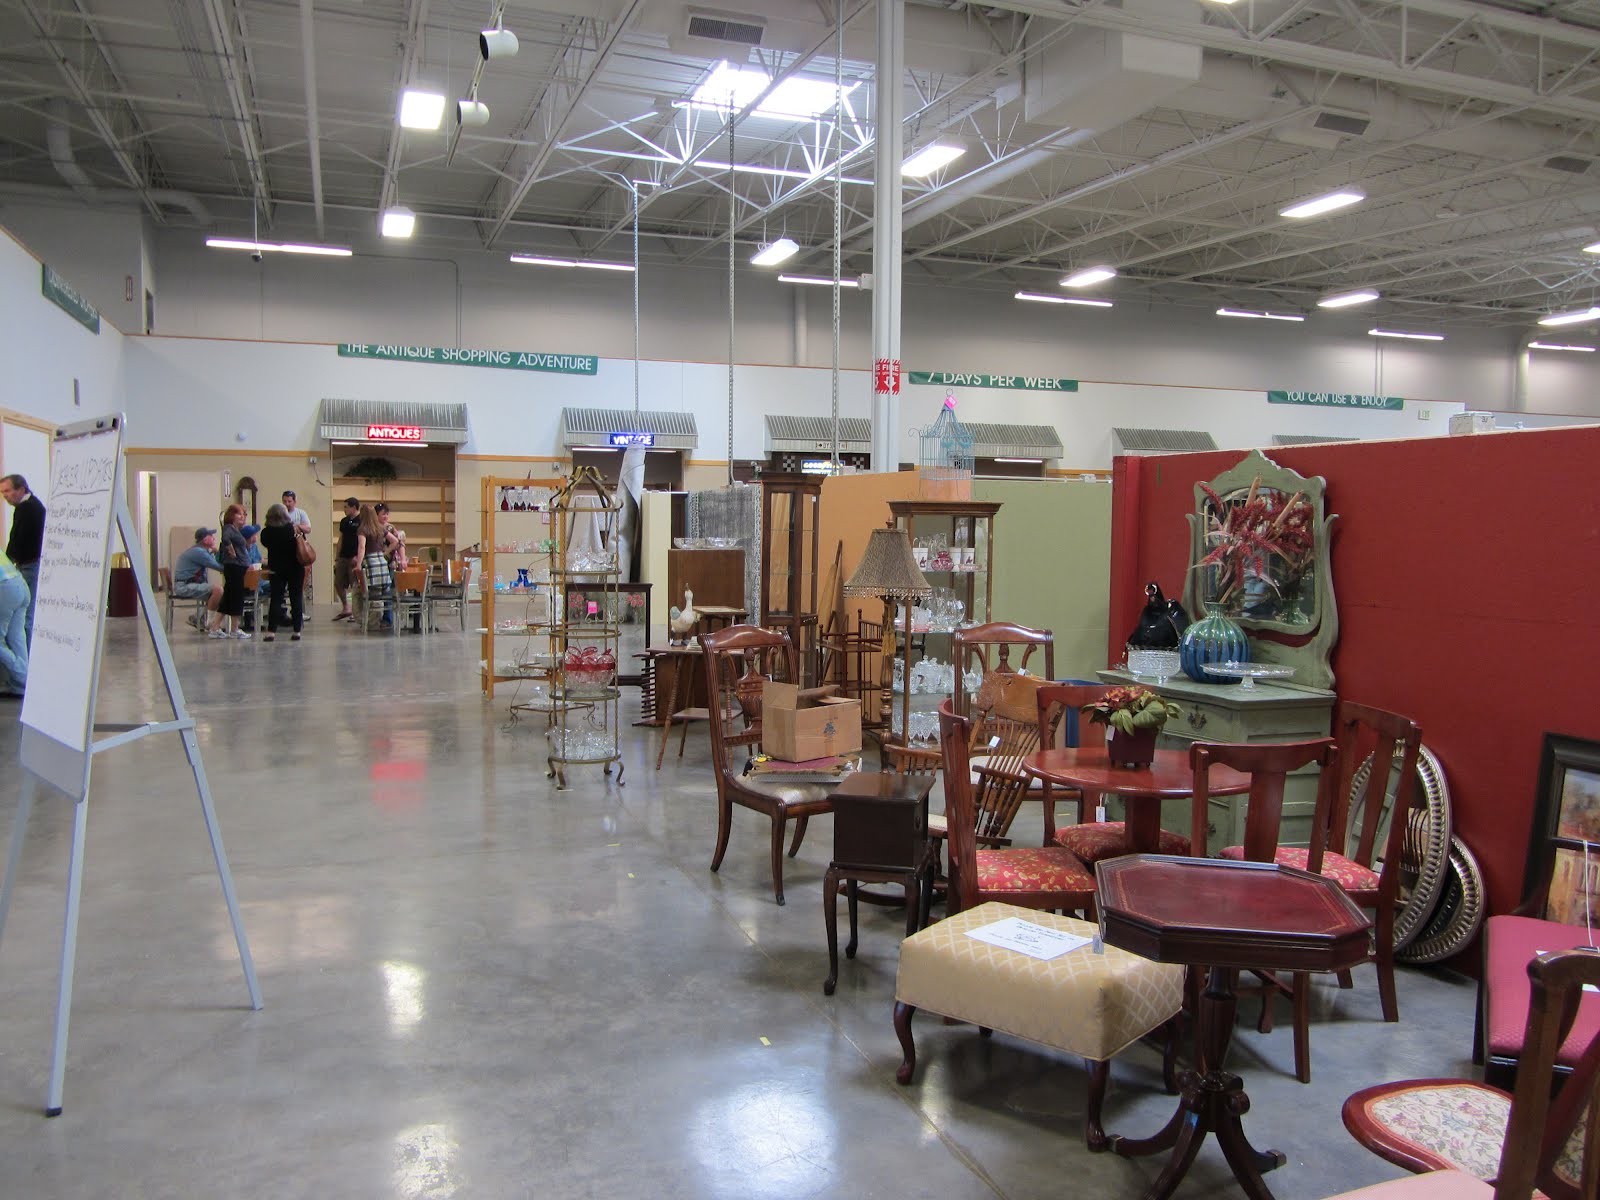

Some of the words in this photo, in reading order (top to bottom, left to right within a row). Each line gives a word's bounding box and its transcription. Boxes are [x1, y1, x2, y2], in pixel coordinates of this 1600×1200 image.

[346, 344, 369, 354] THE
[375, 345, 435, 359] ANTIQUE
[442, 348, 511, 364] SHOPPING
[517, 353, 592, 371] ADVENTURE
[942, 373, 982, 386] DAYS
[989, 375, 1016, 387] PER
[1023, 377, 1062, 390] WEEK
[1286, 391, 1305, 402] YOU
[1308, 392, 1329, 403] CAN
[1331, 394, 1347, 405] USE
[1350, 395, 1357, 405] &
[1361, 396, 1388, 407] ENJOY
[369, 427, 420, 439] ANTIQUES
